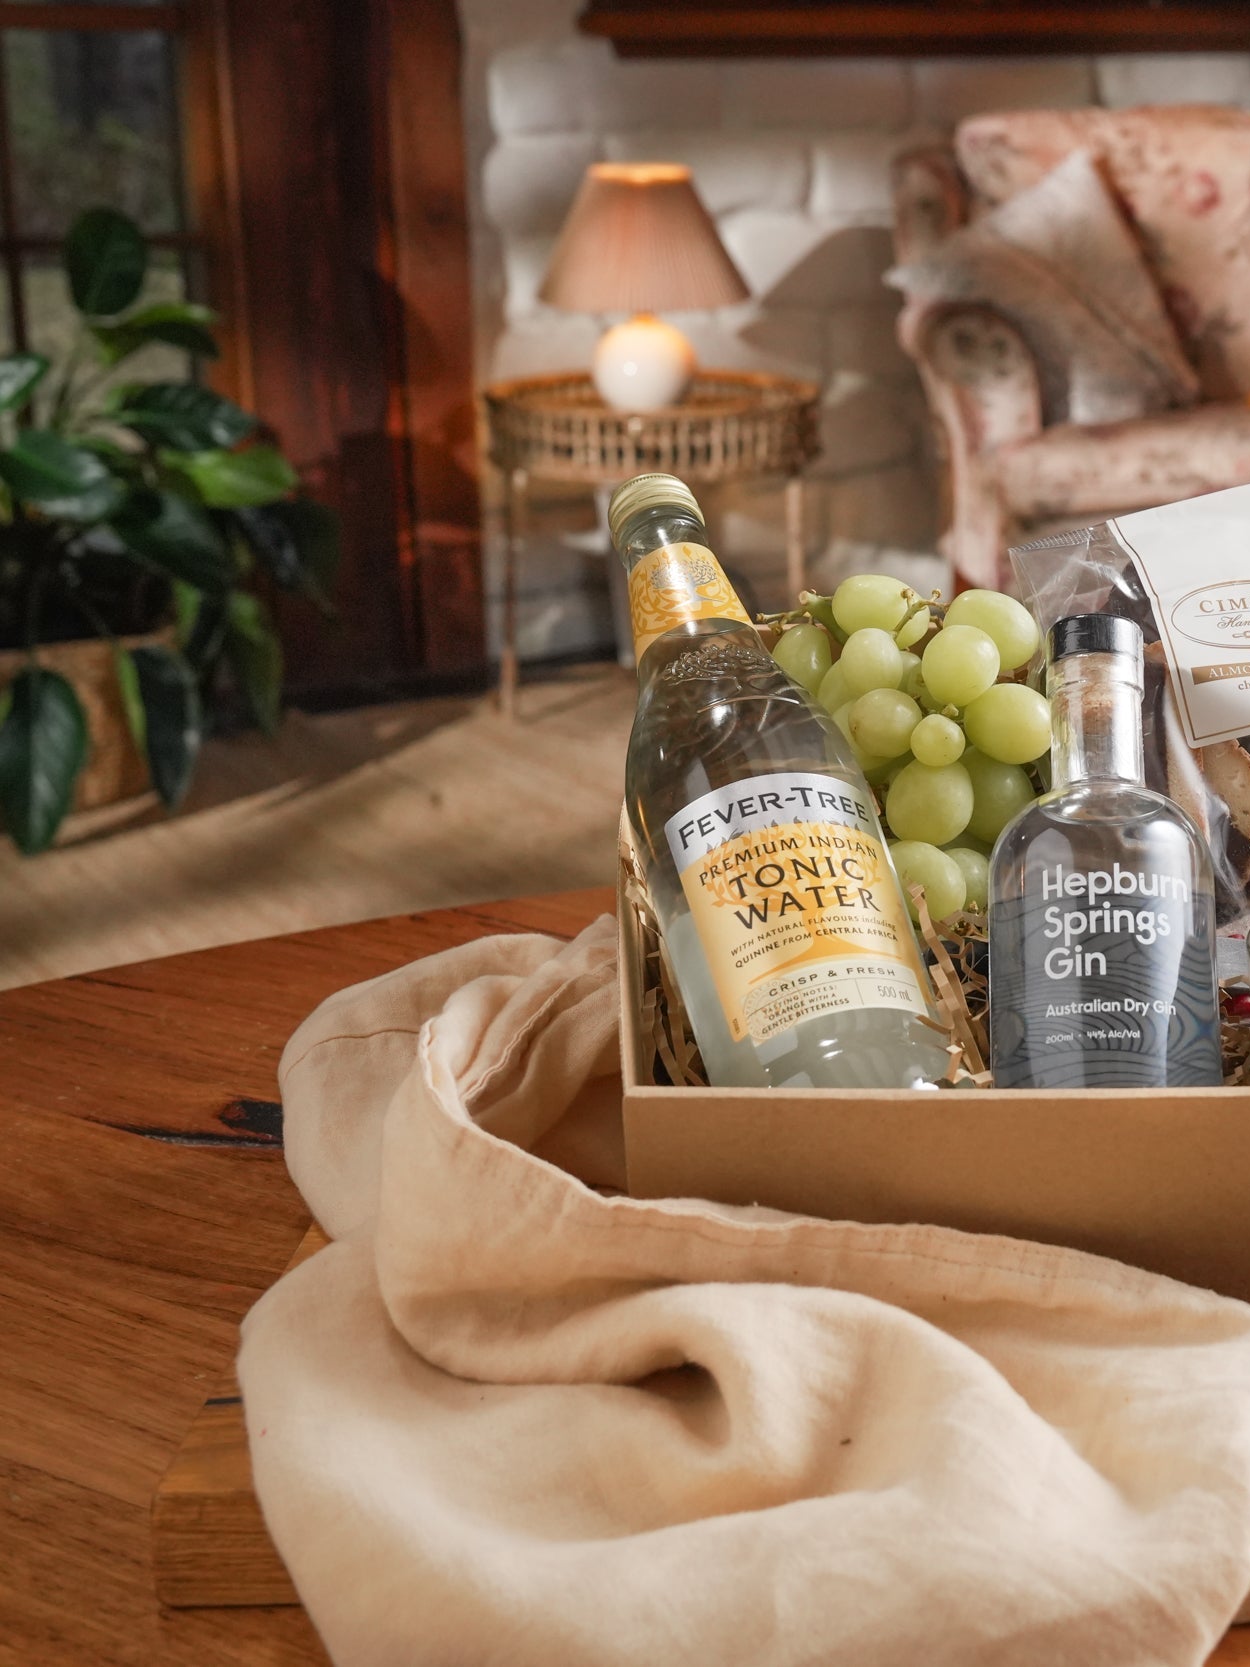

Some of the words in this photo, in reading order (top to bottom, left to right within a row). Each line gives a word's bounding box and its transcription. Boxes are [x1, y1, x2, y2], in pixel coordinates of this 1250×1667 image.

[678, 787, 870, 850] FEVER-TREE
[699, 838, 800, 887] PREMIUM
[809, 835, 878, 861] INDIAN
[728, 857, 866, 899] TONIC
[1042, 863, 1188, 906] Hepburn
[733, 885, 882, 930] WATER
[1044, 901, 1171, 947] Springs
[730, 938, 755, 957] WITH
[757, 921, 805, 941] NATURAL
[808, 915, 859, 925] FLAVOURS
[735, 941, 781, 968] QUININE
[783, 932, 812, 946] FROM
[815, 927, 864, 937] CENTRAL
[867, 928, 899, 942] AFRICA
[1044, 945, 1107, 979] Gin
[768, 974, 818, 997] CRISP
[827, 970, 837, 978] &
[846, 967, 896, 977] FRESH
[877, 985, 897, 998] 500
[761, 1014, 794, 1035] GENTLE
[795, 997, 850, 1019] BITTERNESS
[762, 993, 800, 1015] TASTING
[768, 1000, 806, 1021] ORANGE
[808, 994, 829, 1004] WITH
[1046, 998, 1121, 1018] Australian
[1124, 998, 1150, 1016] Dry
[1153, 1000, 1177, 1016] Gin
[1046, 1032, 1074, 1044] 200ml
[1086, 1029, 1107, 1040] 44%
[1108, 1029, 1141, 1039] Alc/Vol
